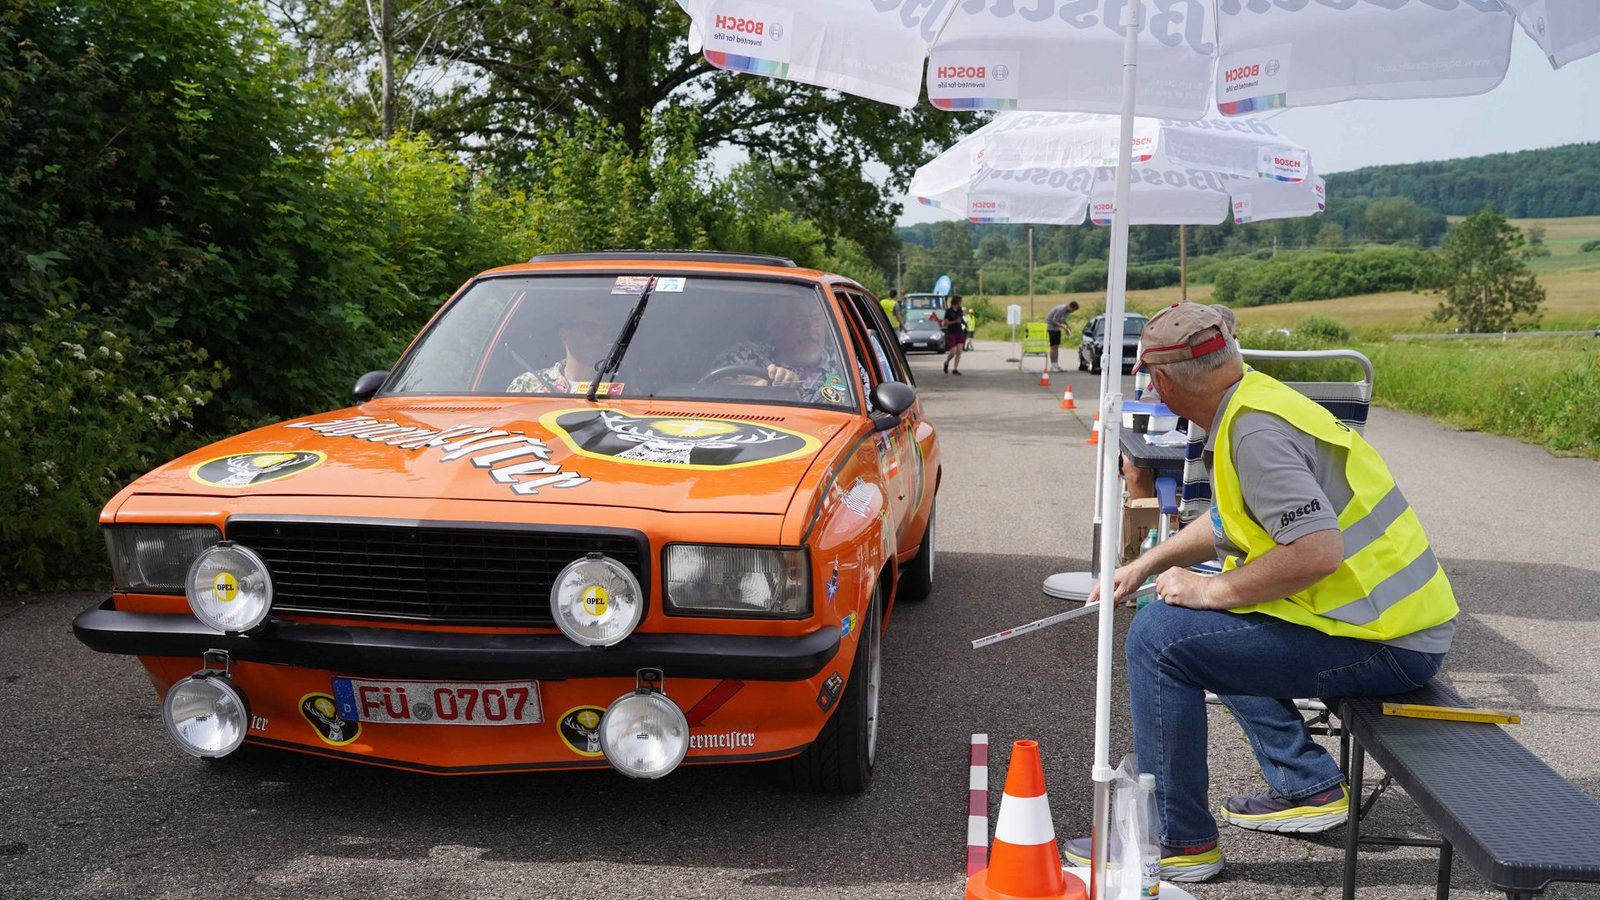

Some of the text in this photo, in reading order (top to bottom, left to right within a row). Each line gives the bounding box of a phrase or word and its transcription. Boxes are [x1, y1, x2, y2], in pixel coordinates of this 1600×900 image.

[1274, 156, 1301, 168] BOSCH
[1280, 498, 1321, 529] Bosch
[586, 597, 605, 605] OPEL
[358, 685, 530, 721] FÜ 0707
